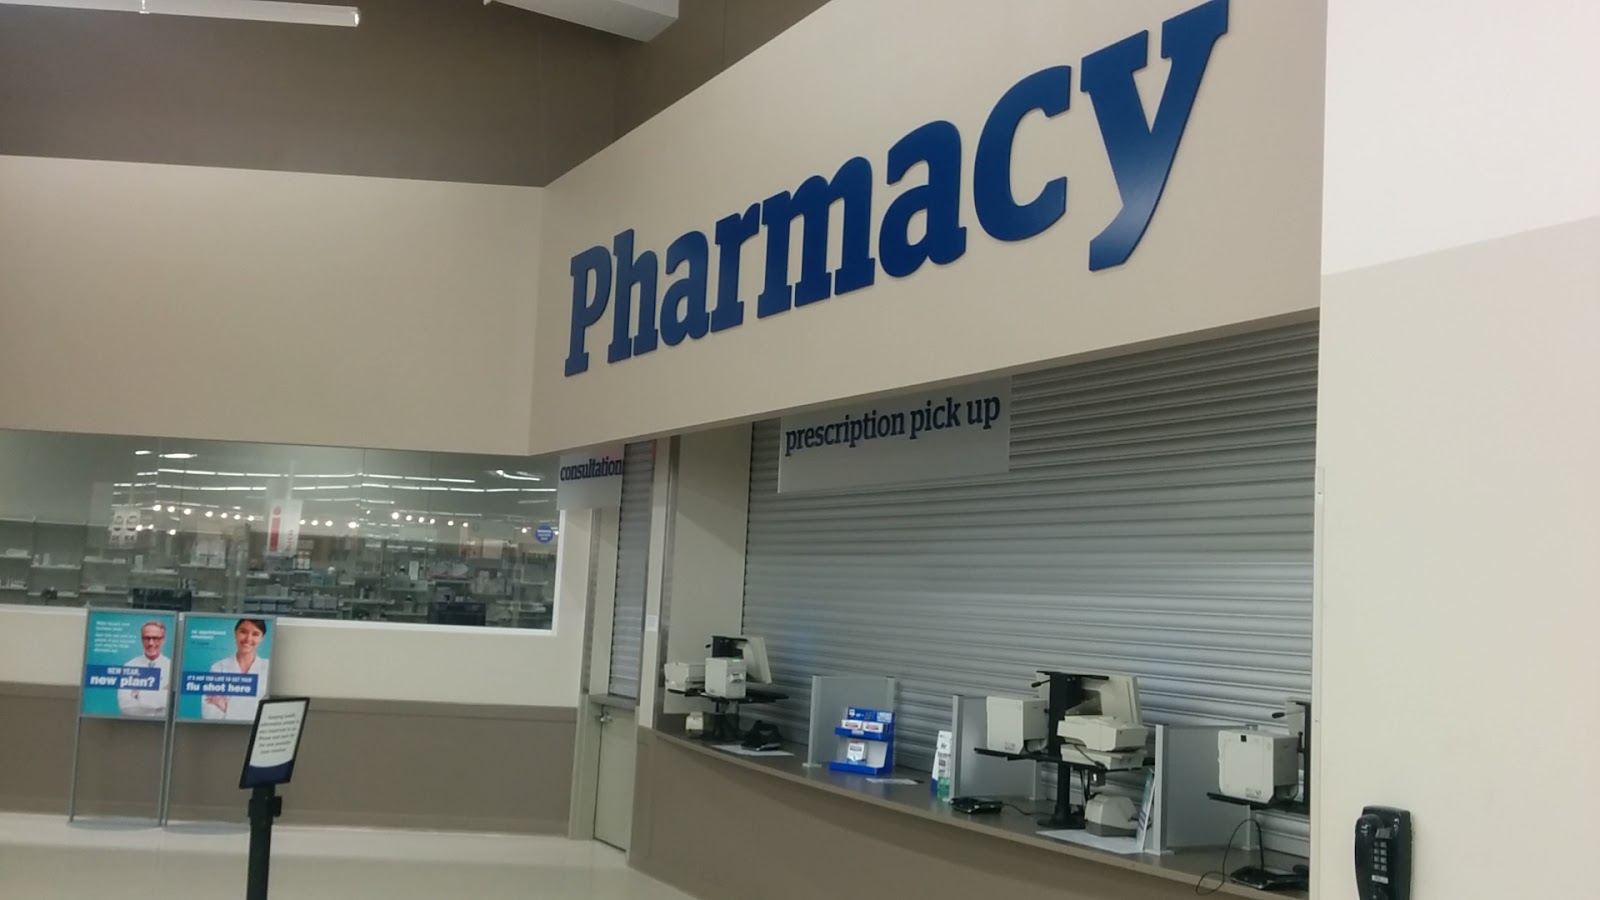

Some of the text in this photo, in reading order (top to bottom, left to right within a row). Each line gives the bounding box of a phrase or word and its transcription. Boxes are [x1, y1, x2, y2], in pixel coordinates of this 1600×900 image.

[564, 0, 1229, 377] Pharmacy
[784, 396, 1001, 457] prescription pick up
[560, 456, 624, 481] consultation
[107, 667, 121, 675] NEW
[90, 676, 155, 688] new plan?
[186, 682, 252, 693] flu shot here
